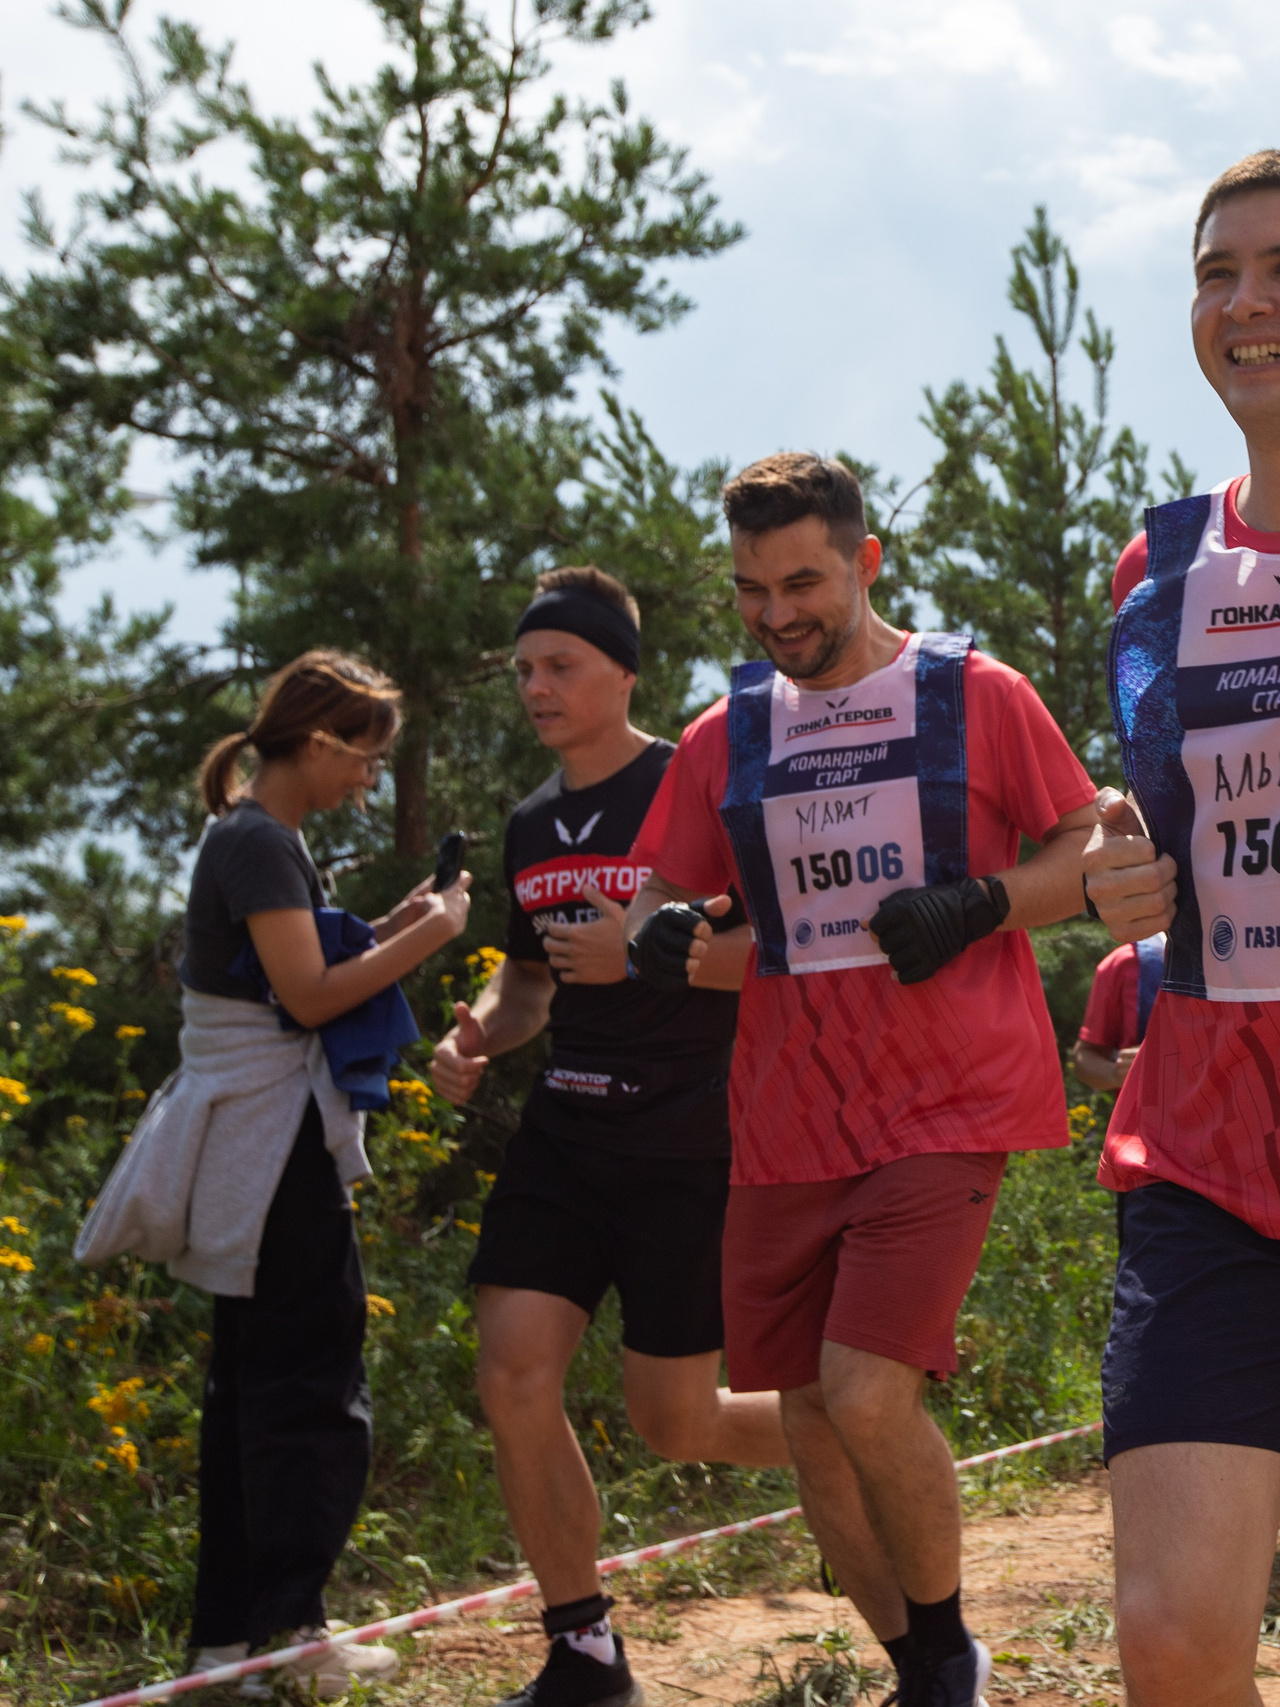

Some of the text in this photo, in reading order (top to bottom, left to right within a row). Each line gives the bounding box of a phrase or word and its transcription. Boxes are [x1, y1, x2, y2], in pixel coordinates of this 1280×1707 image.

[787, 707, 893, 737] ГОНКА ГЕРОЕВ
[788, 742, 888, 773] КОМАНДНЫЙ
[815, 767, 862, 787] СТАРТ
[796, 791, 877, 844] МАРАТ
[790, 842, 903, 894] 15006
